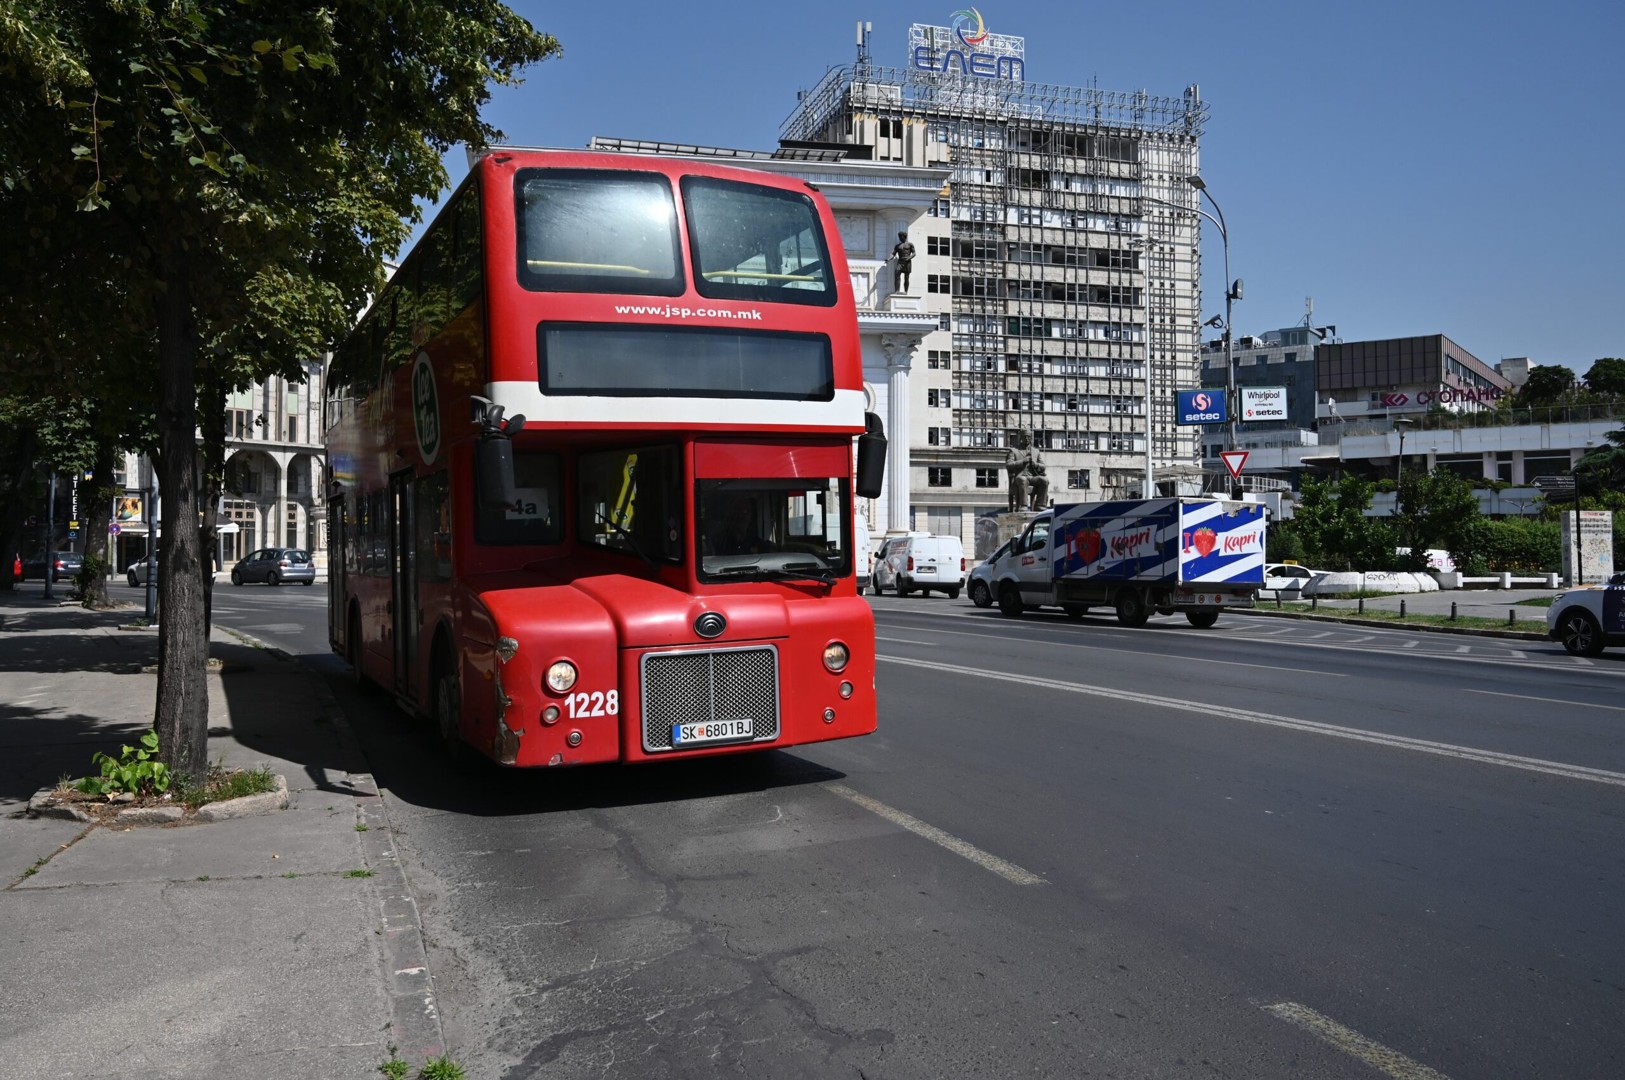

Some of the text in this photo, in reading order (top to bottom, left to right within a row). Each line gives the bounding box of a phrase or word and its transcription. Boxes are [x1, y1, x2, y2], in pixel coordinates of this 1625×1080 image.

[615, 305, 762, 320] www.jsp.com.mk
[417, 363, 431, 407] Ice
[1247, 390, 1280, 401] Whirlpool
[1185, 412, 1220, 421] setec
[1255, 408, 1283, 416] setec
[420, 408, 436, 446] Tea
[1111, 528, 1150, 559] Kapri
[1224, 531, 1257, 553] Kapri
[564, 689, 619, 719] 1228
[682, 725, 697, 740] SK
